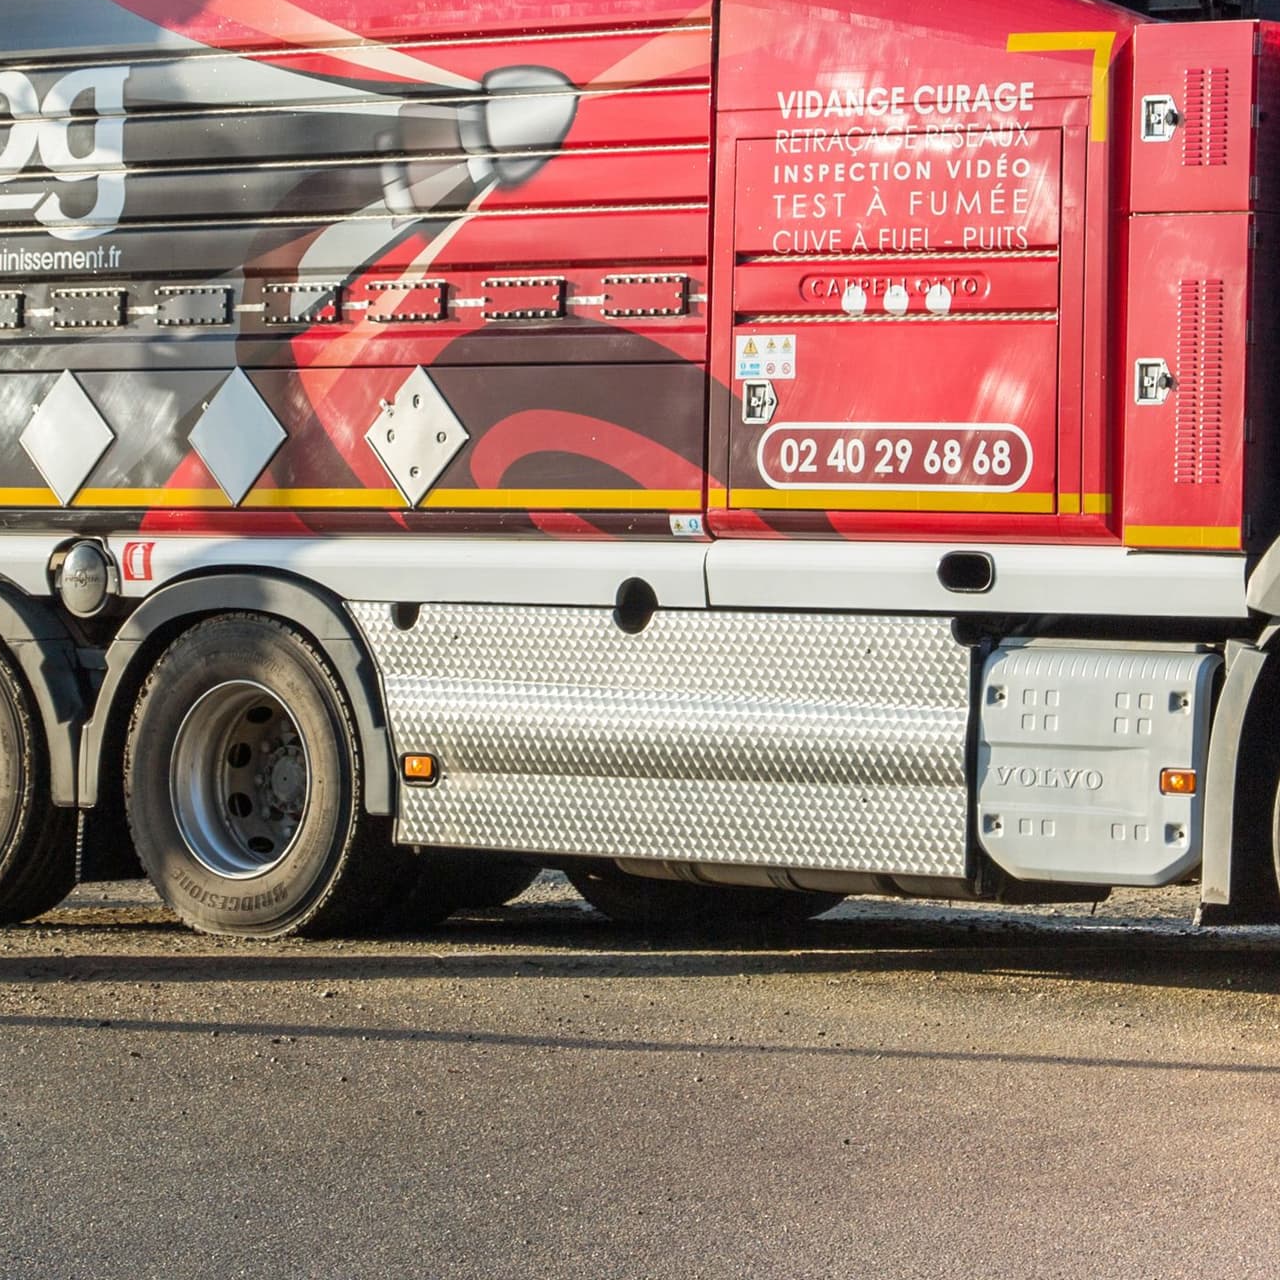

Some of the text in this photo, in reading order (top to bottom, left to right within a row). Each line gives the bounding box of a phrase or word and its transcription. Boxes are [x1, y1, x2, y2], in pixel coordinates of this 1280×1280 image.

[777, 82, 1035, 119] VIDANGE CURAGE
[775, 117, 1031, 156] RETRAÇAGE RÉSEAUX
[773, 153, 1031, 184] INSPECTION VIDÉO
[773, 183, 1029, 219] TEST À FUMÉE
[773, 230, 842, 254] CUVE
[852, 224, 868, 252] À
[879, 228, 934, 252] FUEL
[964, 226, 1029, 251] PUITS
[780, 438, 1011, 476] 02 40 29 68 68
[996, 764, 1104, 791] VOLVO
[170, 868, 289, 913] BRIDGESTONE
